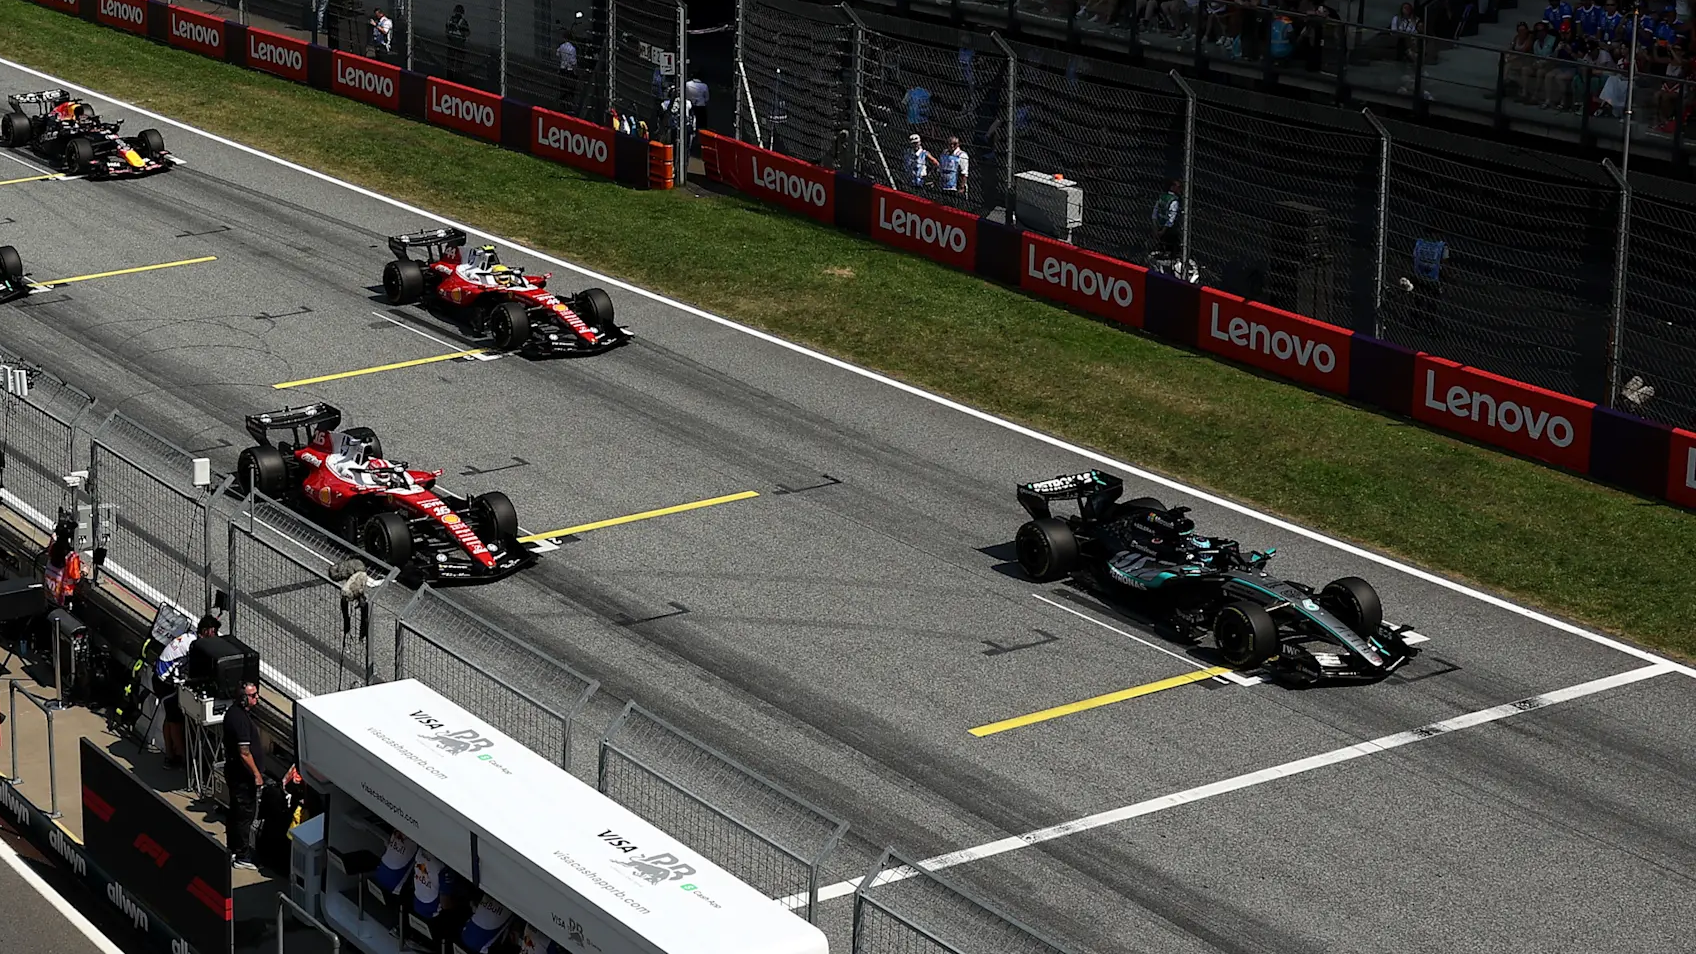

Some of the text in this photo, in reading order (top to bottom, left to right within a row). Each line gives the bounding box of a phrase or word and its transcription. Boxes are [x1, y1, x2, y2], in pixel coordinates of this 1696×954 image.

[172, 12, 220, 47] Lenovo
[250, 34, 303, 71] Lenovo
[337, 58, 394, 98] Lenovo
[432, 85, 495, 128] Lenovo
[537, 117, 608, 163] Lenovo
[752, 155, 827, 207] Lenovo
[879, 196, 967, 253] Lenovo
[444, 246, 456, 259] 44
[1027, 243, 1133, 308] Lenovo
[1210, 302, 1336, 374] Lenovo
[1425, 368, 1574, 448] Lenovo
[313, 430, 326, 446] 16
[433, 505, 451, 516] 16
[1109, 567, 1148, 591] PETRONAS
[1282, 644, 1300, 656] IWC
[409, 709, 444, 730] VISA
[367, 727, 448, 780] visacashapprb.com
[48, 829, 87, 876] allwyn
[597, 828, 638, 853] VISA
[553, 849, 651, 915] visacashapprb.com
[106, 881, 149, 932] allwyn
[551, 912, 566, 930] VISA
